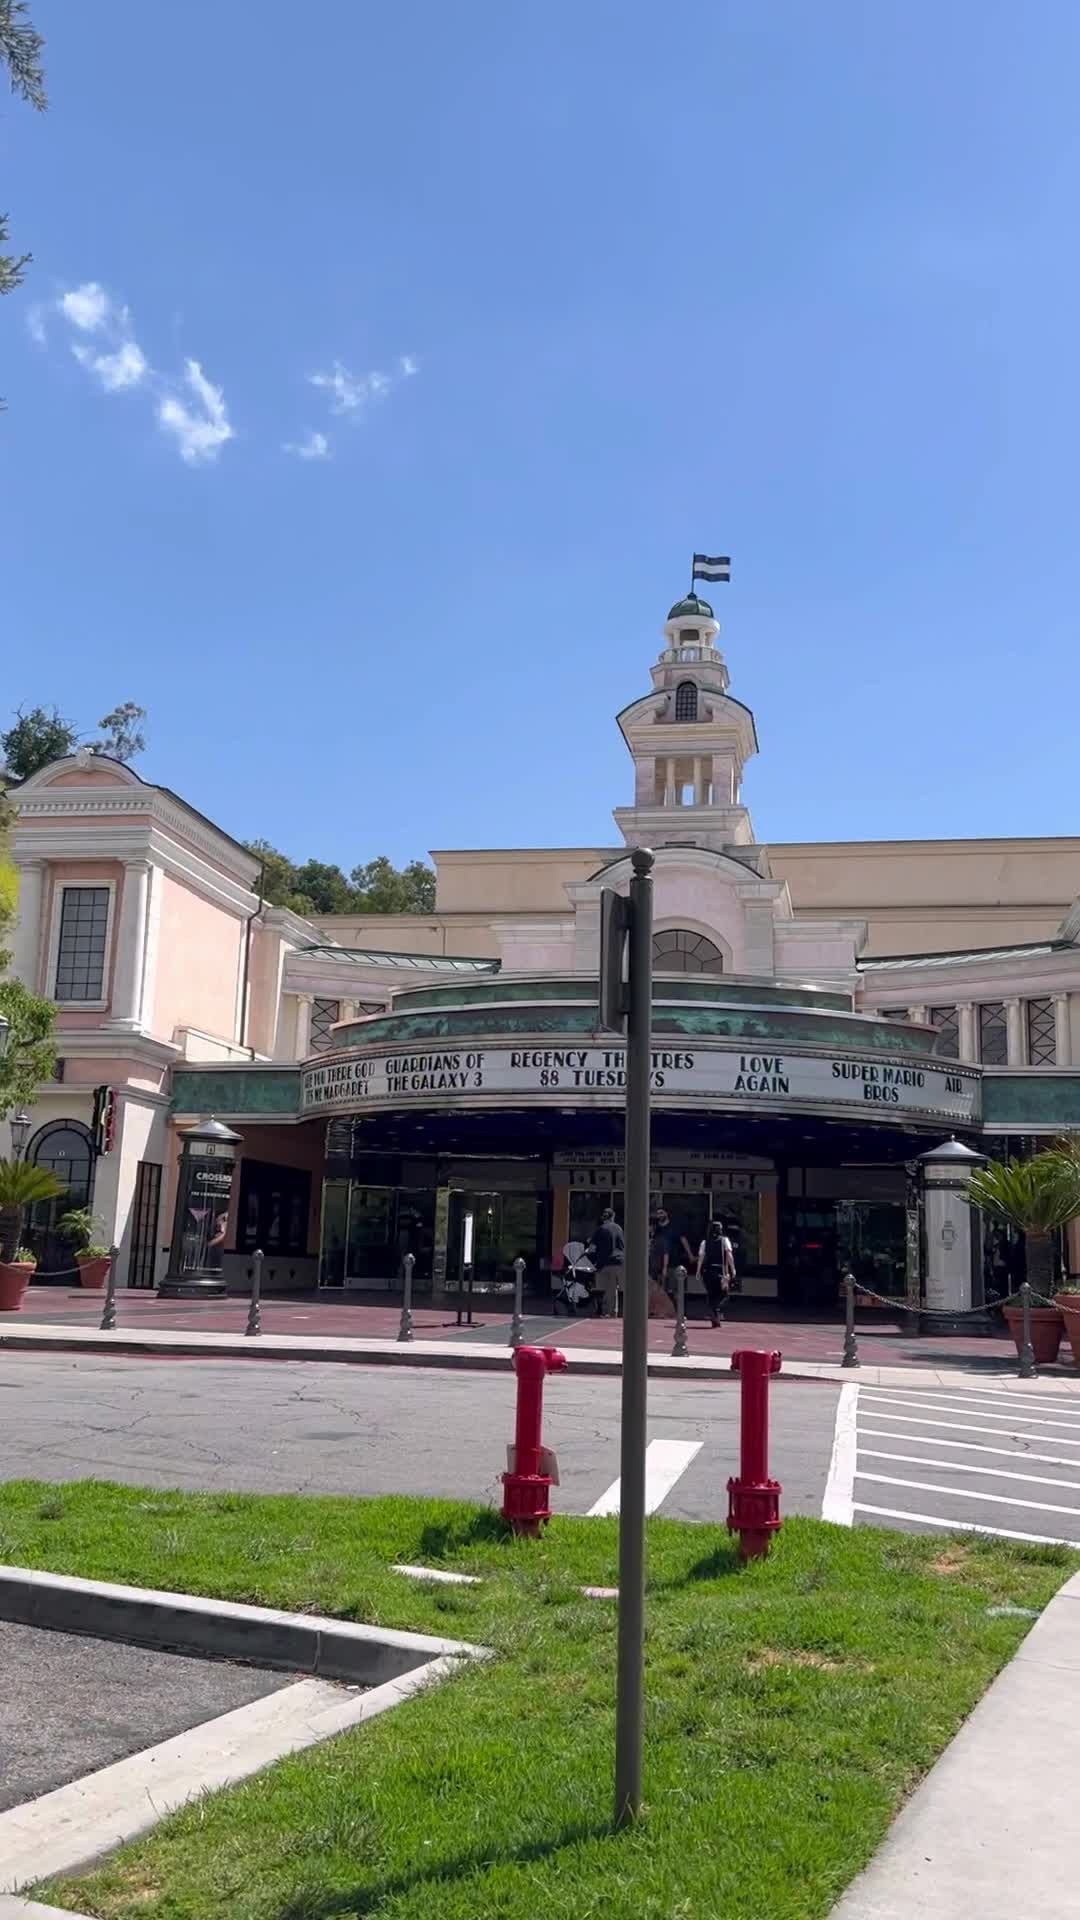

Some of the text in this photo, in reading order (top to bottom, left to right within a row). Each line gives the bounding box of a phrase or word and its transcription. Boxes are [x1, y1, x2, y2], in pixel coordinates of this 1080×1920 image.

[385, 1053, 484, 1074] GUARDIANS OF
[511, 1051, 694, 1069] REGENCY THTRES
[740, 1056, 784, 1074] LOVE
[328, 1065, 352, 1083] THERE
[355, 1062, 375, 1078] GOD
[387, 1071, 483, 1092] THE GALAXY 3
[573, 1070, 665, 1088] TUESDS
[832, 1062, 925, 1088] SUPER MARIO
[324, 1080, 368, 1099] MARGARET
[734, 1075, 789, 1093] AGAIN
[864, 1084, 899, 1102] BROS
[945, 1076, 963, 1094] AIR
